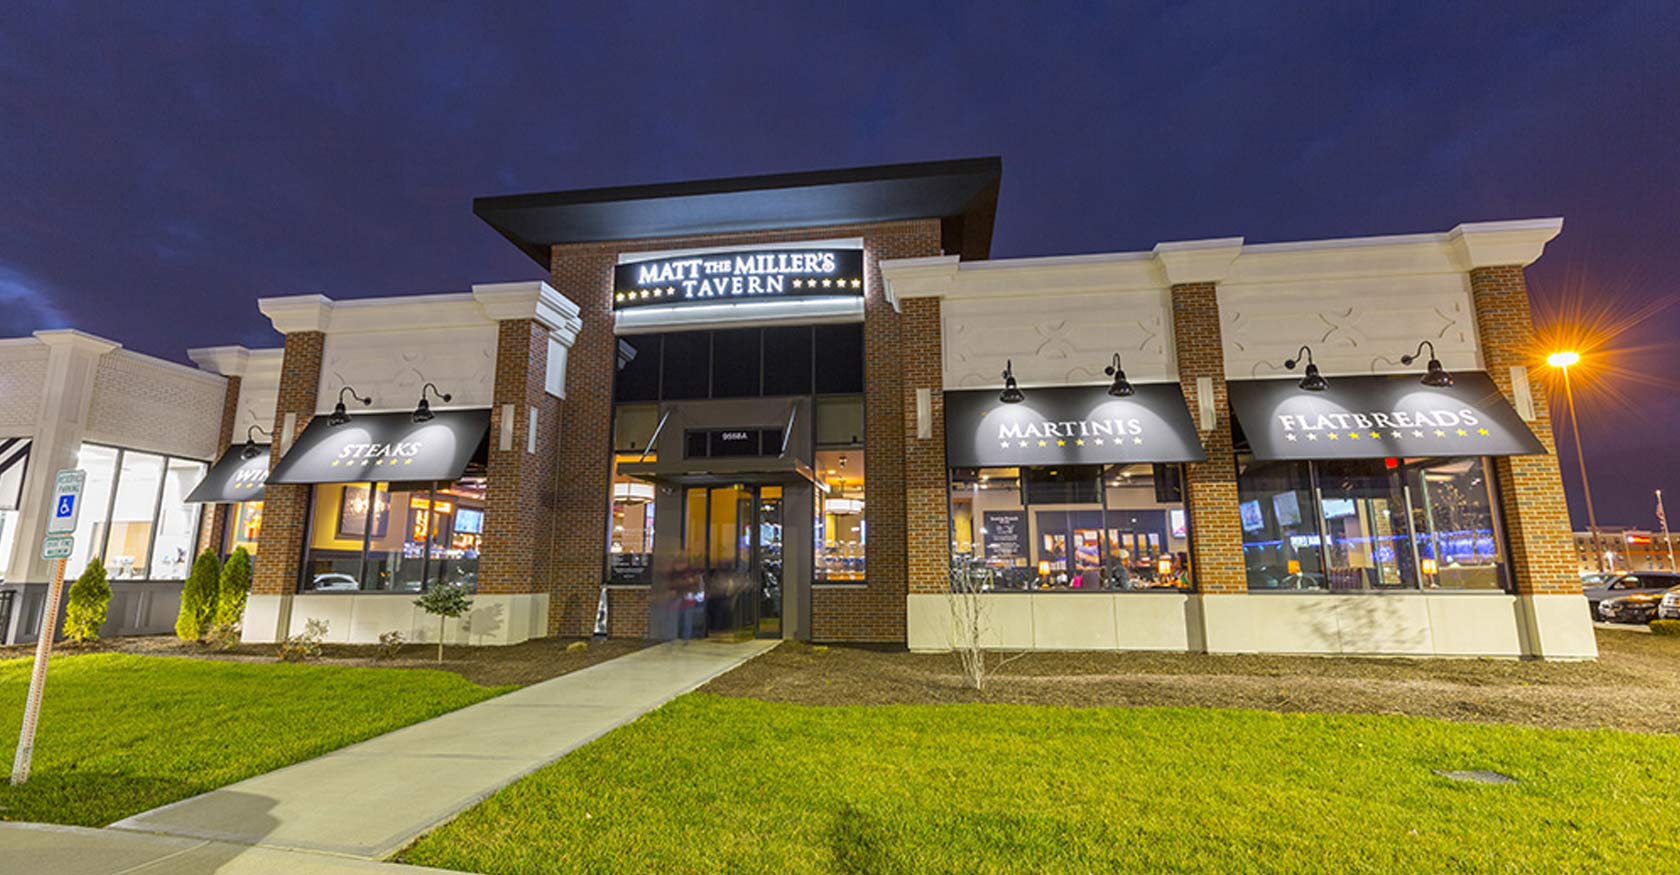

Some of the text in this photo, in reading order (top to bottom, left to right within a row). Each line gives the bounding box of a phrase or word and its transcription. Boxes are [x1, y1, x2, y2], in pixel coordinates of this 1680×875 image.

[638, 253, 834, 283] MATT THE MILLER'S
[683, 275, 783, 297] TAVERN
[998, 419, 1142, 438] MARTINIS
[1278, 409, 1478, 430] FLATBREADS
[338, 442, 422, 458] STEAKS
